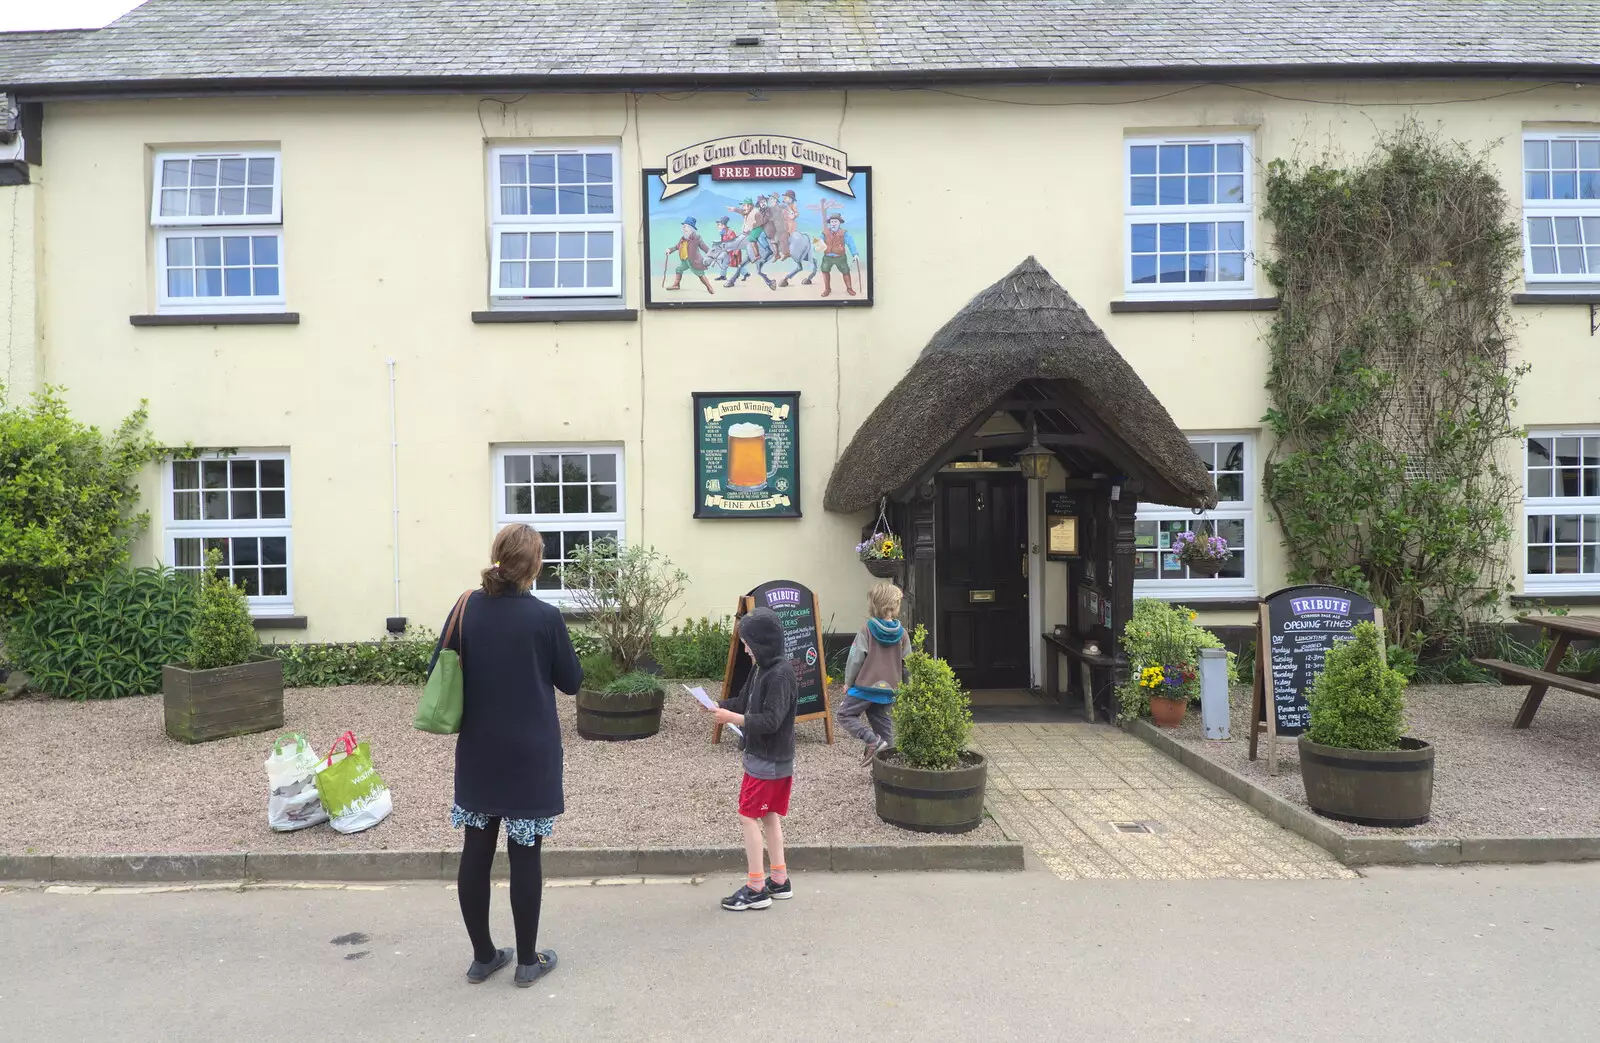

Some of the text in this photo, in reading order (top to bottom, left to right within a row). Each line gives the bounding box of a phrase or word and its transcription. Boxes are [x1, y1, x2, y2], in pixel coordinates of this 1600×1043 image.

[672, 138, 842, 174] The Tom Cobley Tavern
[719, 166, 795, 178] FREE HOUSE
[721, 402, 773, 413] Award Winning
[723, 500, 771, 509] FINE ALES
[767, 590, 799, 603] TRIBUTE
[1293, 600, 1348, 612] TRIBUTE
[1283, 619, 1352, 630] OPENING TIMES
[1271, 646, 1290, 655] Monday
[1272, 655, 1293, 663] Tuesday
[1275, 694, 1295, 703] Sunday
[1277, 705, 1296, 713] Please
